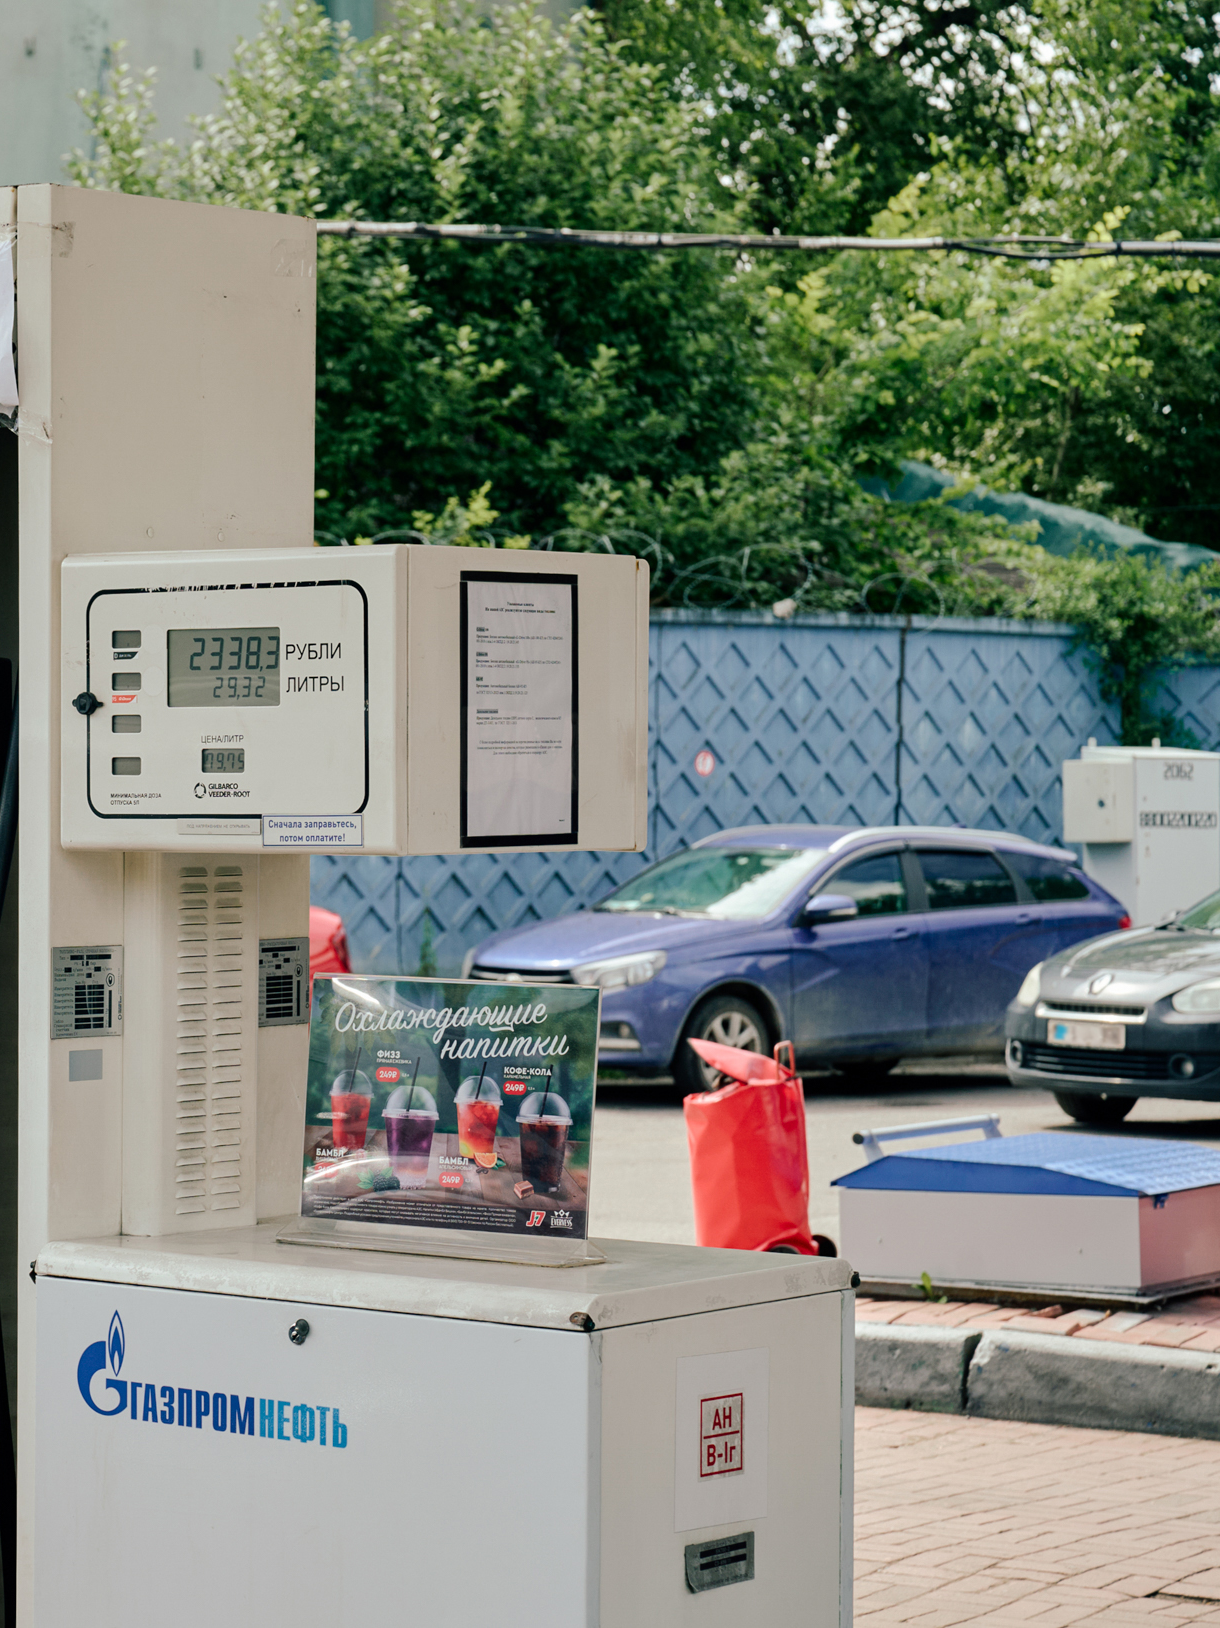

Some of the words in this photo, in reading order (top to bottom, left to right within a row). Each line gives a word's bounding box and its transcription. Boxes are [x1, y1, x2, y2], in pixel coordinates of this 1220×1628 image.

[189, 635, 280, 672] 2338,3
[285, 642, 342, 661] РУБЛИ
[212, 676, 266, 700] 29,32
[286, 675, 345, 693] ЛИТРЫ
[200, 734, 245, 744] ЦЕНА/ЛИТР
[1164, 762, 1194, 781] 2062
[268, 819, 302, 828] Сначала
[304, 820, 357, 830] заправьтесь,
[305, 833, 346, 842] оплатите!
[335, 1002, 548, 1044] Охлаждающие
[377, 1050, 401, 1058] ФИЗЗ
[440, 1034, 570, 1060] напитки
[504, 1066, 552, 1076] КОФЕ-КОЛА
[316, 1148, 345, 1157] БАМБЛ
[439, 1156, 469, 1165] БАМБЛ
[129, 1381, 348, 1449] ГАЗПРОМНЕФТЬ
[712, 1406, 732, 1431] АН
